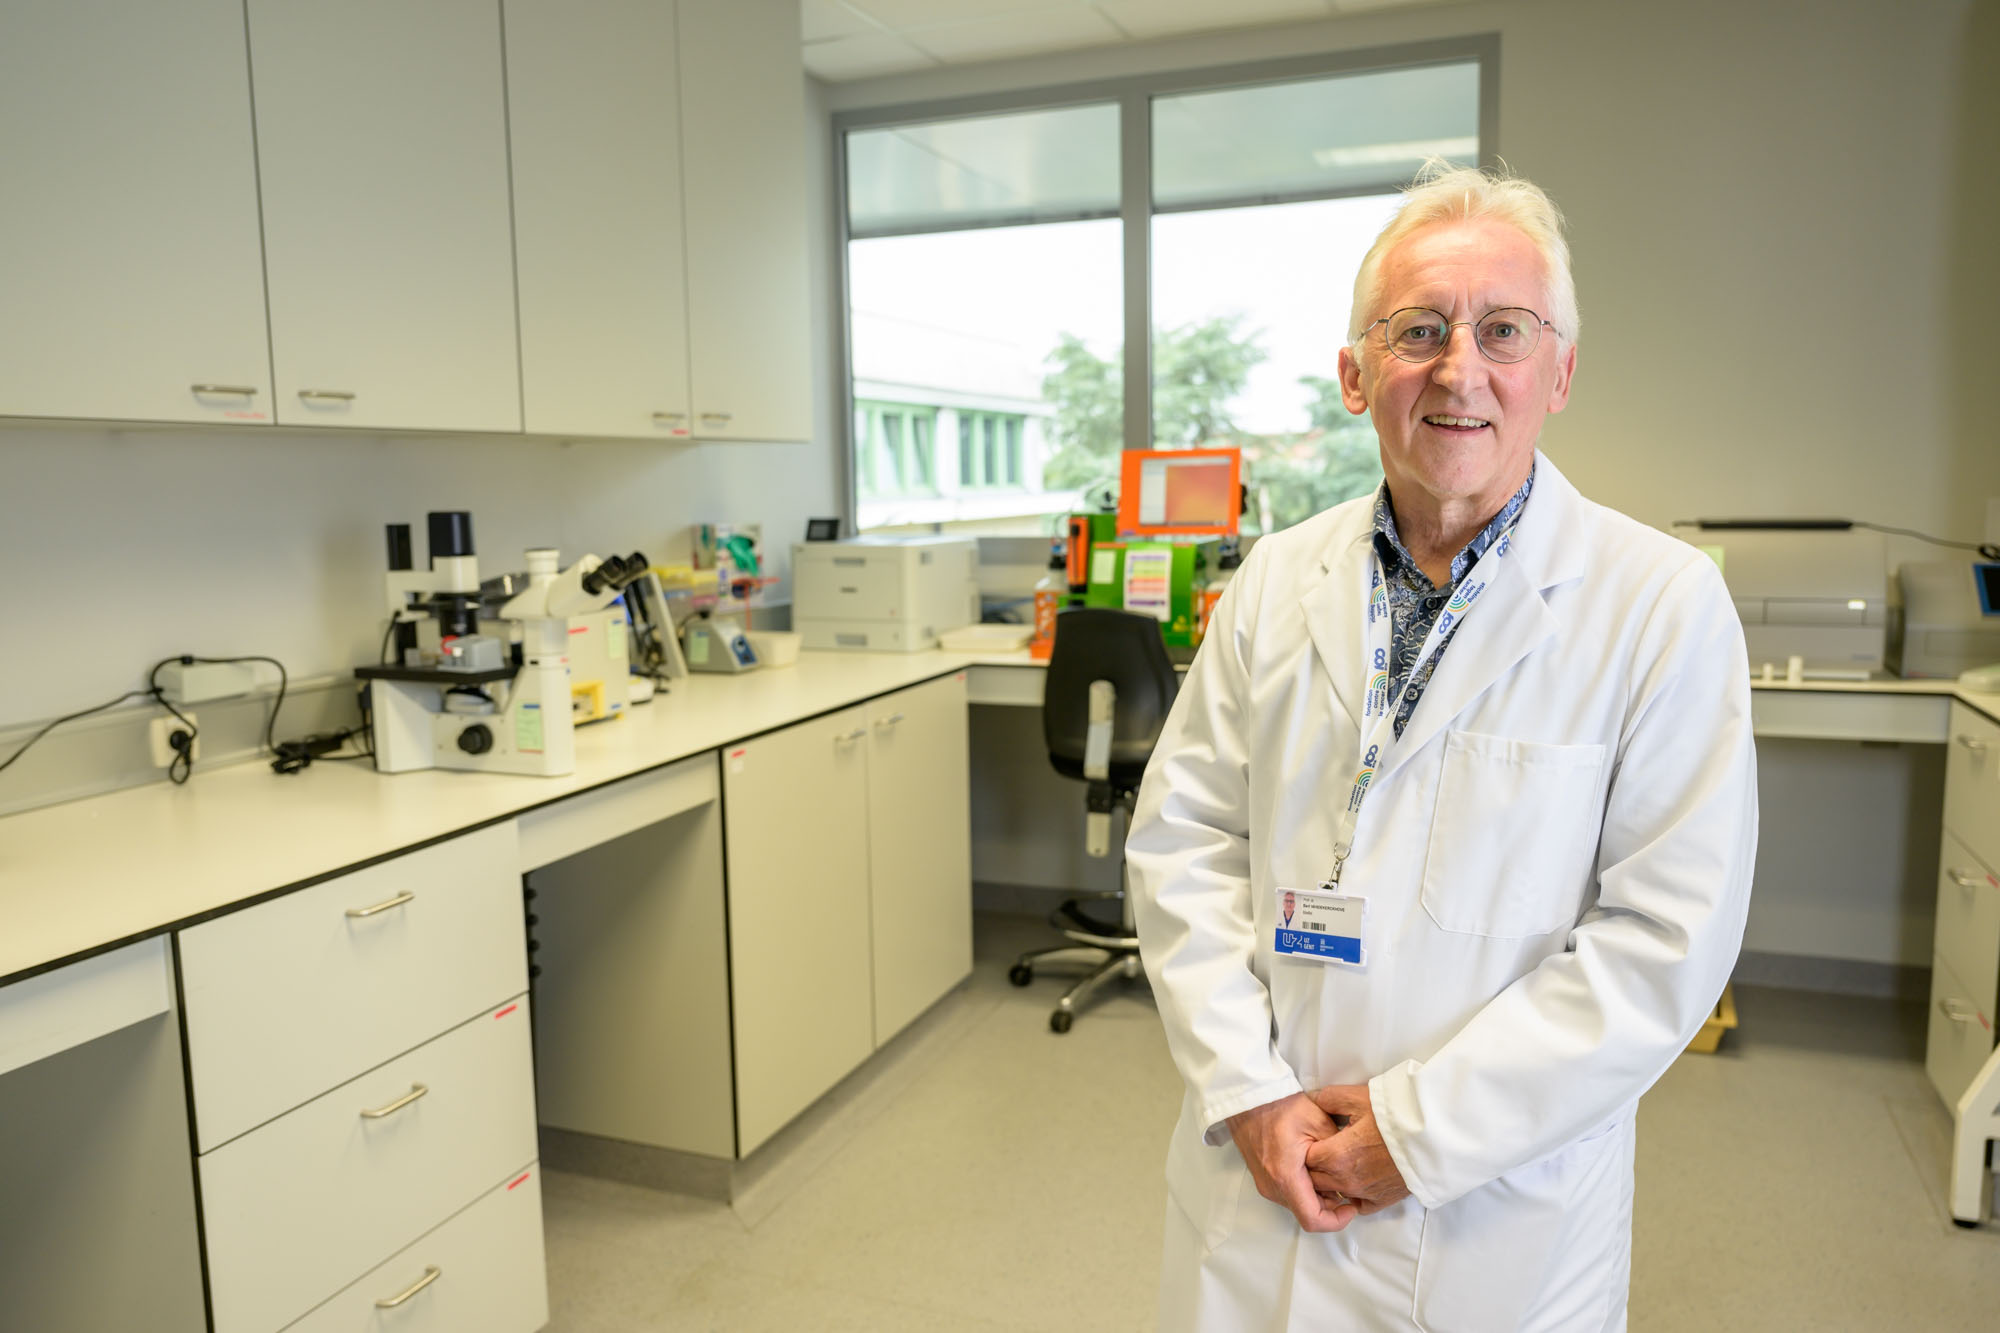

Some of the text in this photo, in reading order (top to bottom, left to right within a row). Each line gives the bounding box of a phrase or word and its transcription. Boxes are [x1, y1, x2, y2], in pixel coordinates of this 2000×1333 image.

[1459, 578, 1473, 595] kanker
[1463, 584, 1476, 599] tegen
[1467, 582, 1486, 603] stichting
[1438, 612, 1454, 635] 100
[1374, 648, 1386, 671] 100
[1365, 689, 1373, 717] fondation
[1363, 744, 1379, 768] 100
[1348, 784, 1357, 811] fondation
